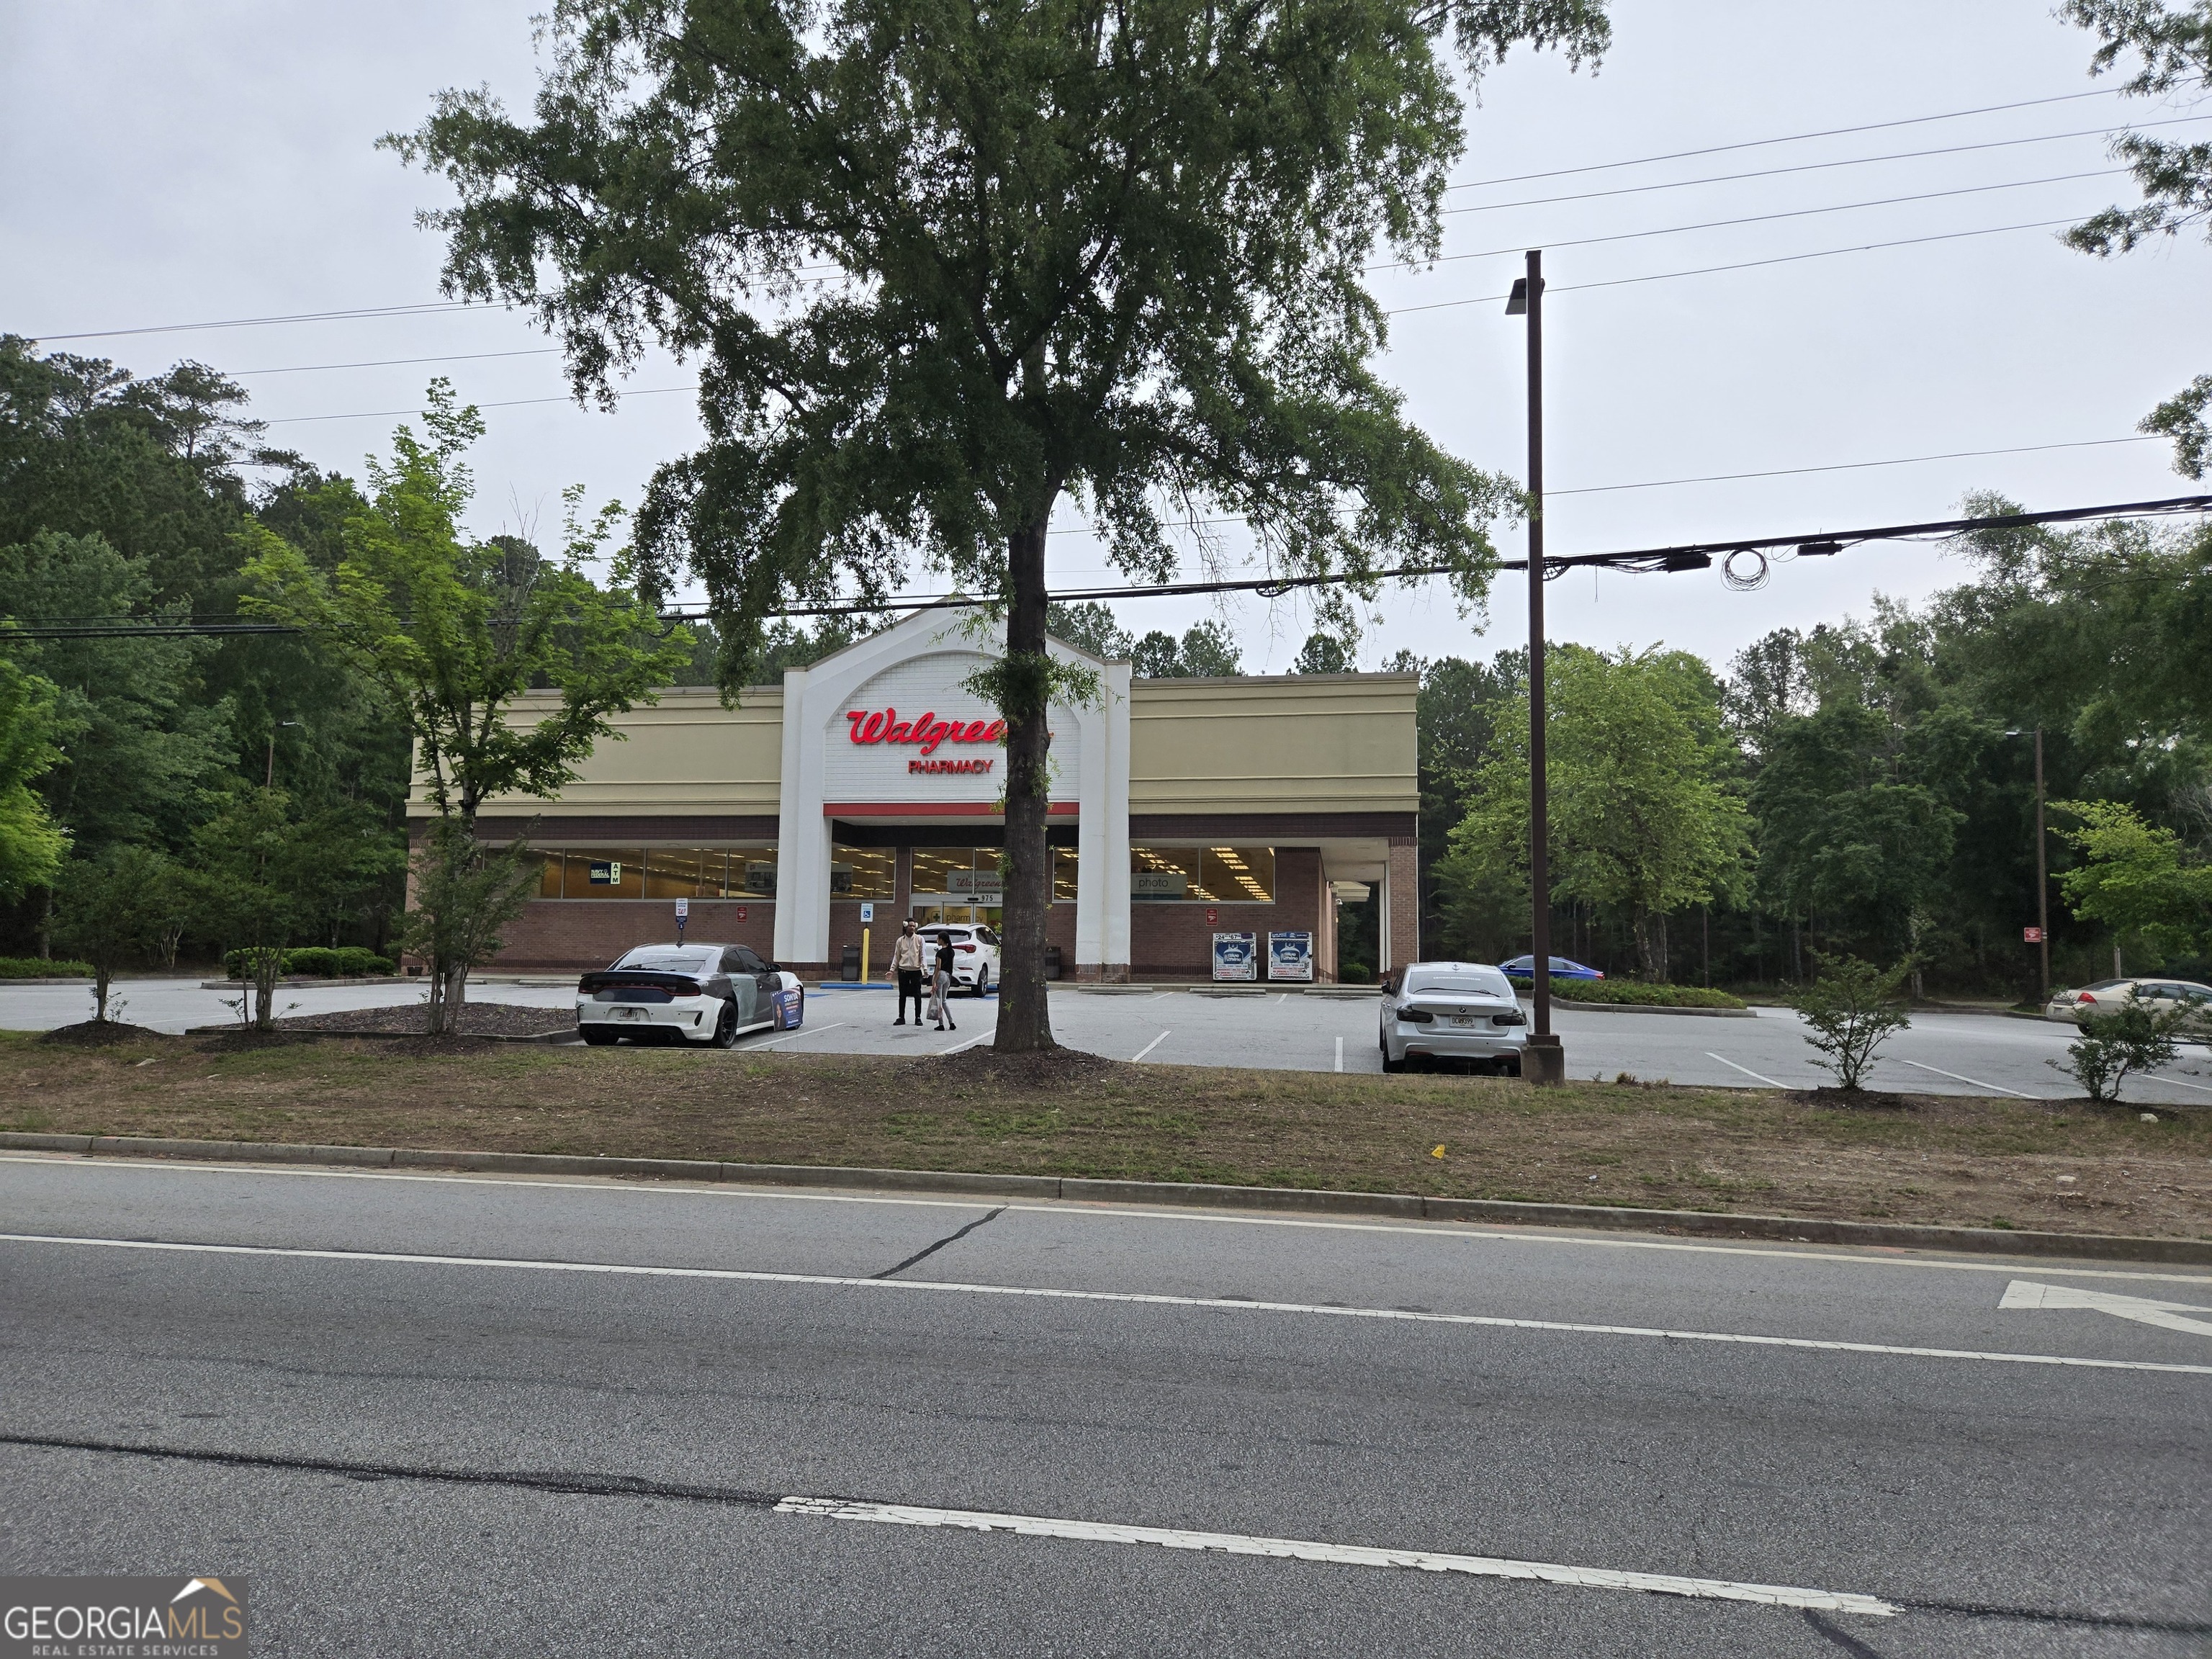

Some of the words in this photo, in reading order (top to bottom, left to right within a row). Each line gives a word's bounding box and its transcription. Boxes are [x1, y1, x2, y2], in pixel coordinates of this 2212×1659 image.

[847, 708, 1054, 755] Walgree
[909, 760, 994, 774] PHARMACY
[1139, 878, 1169, 889] photo
[946, 912, 984, 922] pharmcy
